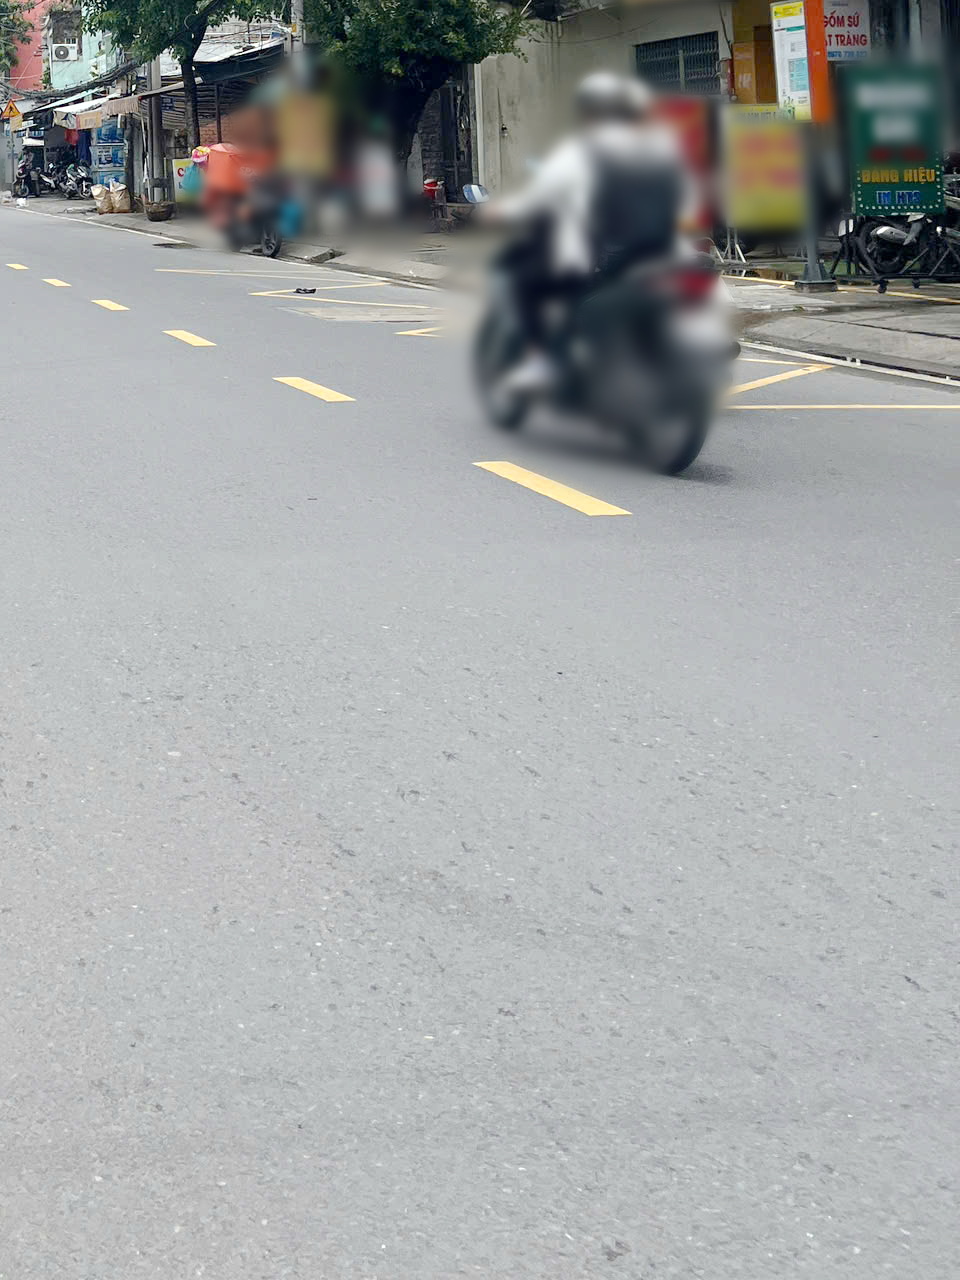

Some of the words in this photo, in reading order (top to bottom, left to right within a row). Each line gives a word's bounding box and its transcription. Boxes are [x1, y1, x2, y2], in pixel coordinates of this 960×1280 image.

[847, 11, 864, 28] SỨ
[835, 31, 867, 47] TRÀNG
[903, 166, 936, 184] HIỆU
